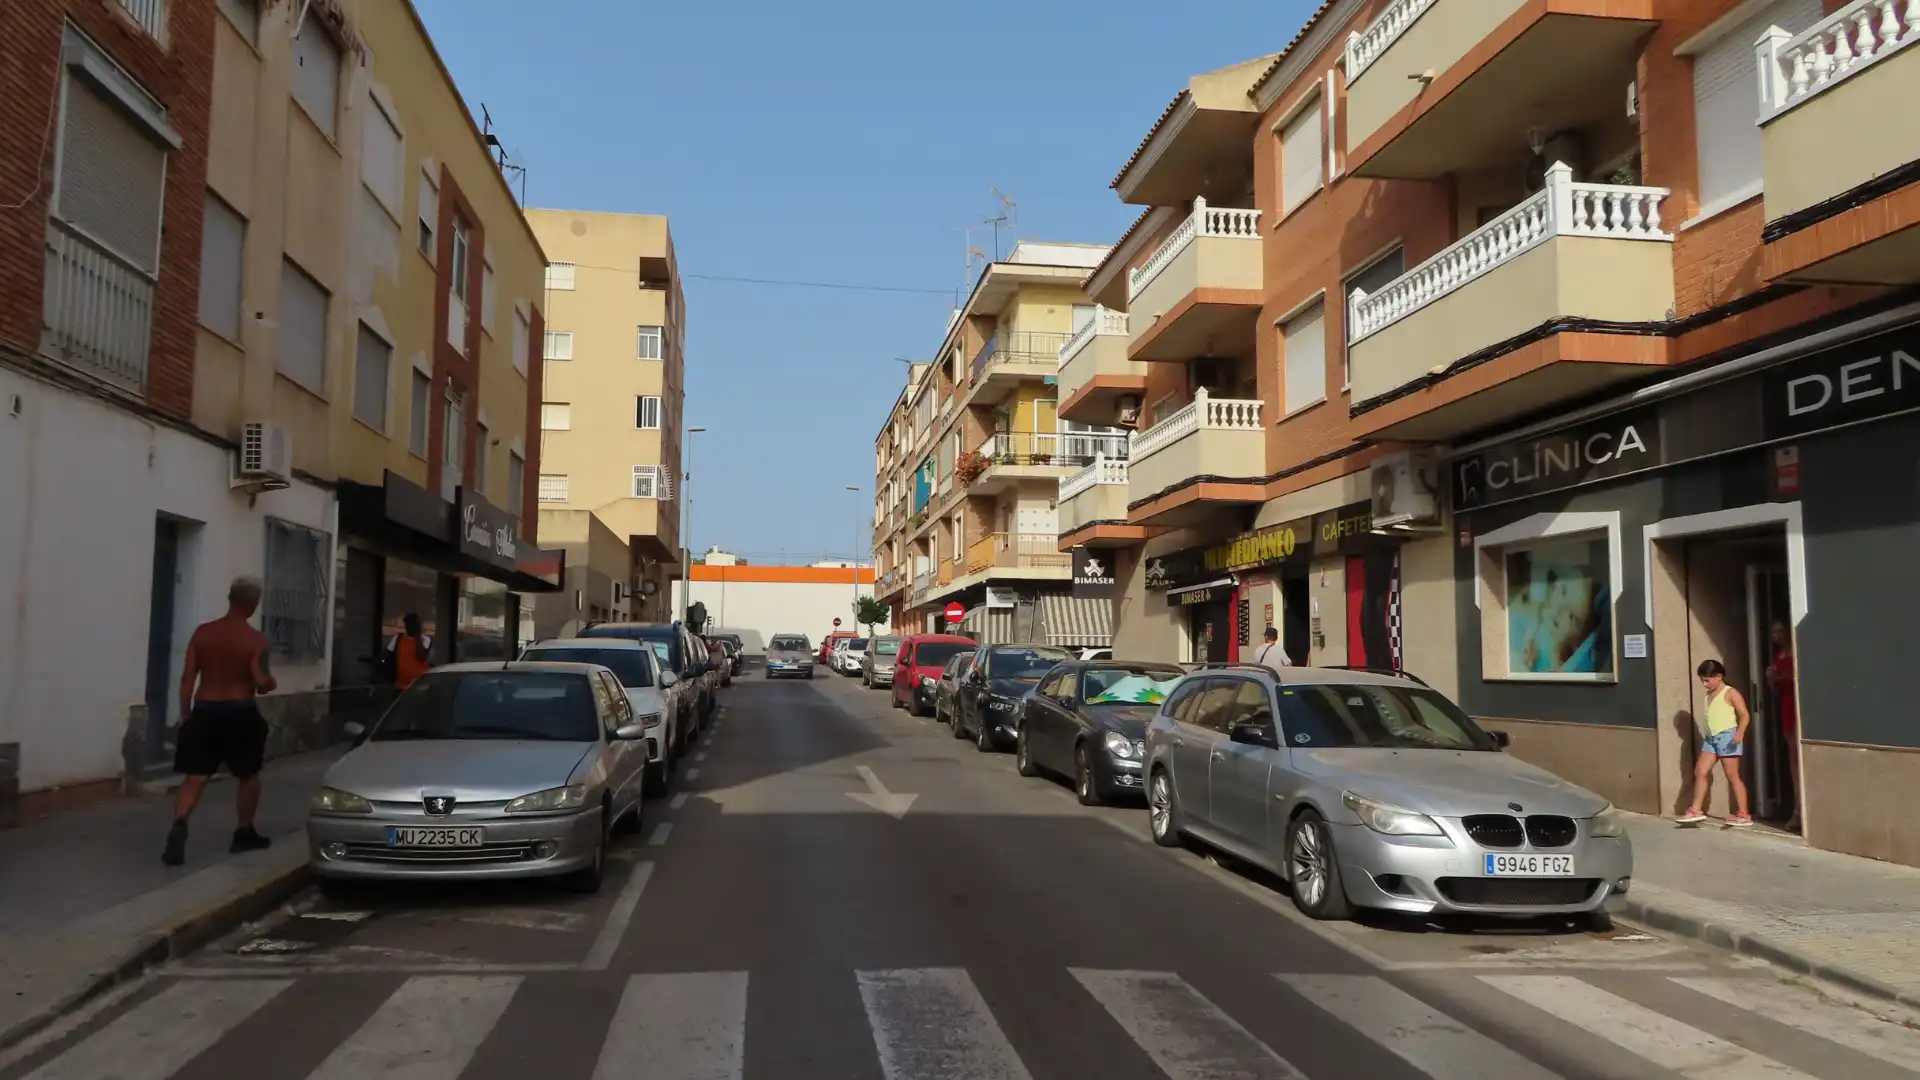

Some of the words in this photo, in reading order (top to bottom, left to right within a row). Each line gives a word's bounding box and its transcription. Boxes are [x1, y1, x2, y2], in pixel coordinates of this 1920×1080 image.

[1486, 425, 1647, 489] CLÍNICA
[1074, 577, 1115, 585] BIMASER
[1181, 590, 1205, 605] BIMASER
[395, 830, 415, 844] MU
[418, 830, 456, 845] 2235
[460, 830, 479, 844] CK
[1497, 857, 1537, 872] 9946
[1542, 857, 1571, 872] FGZ
